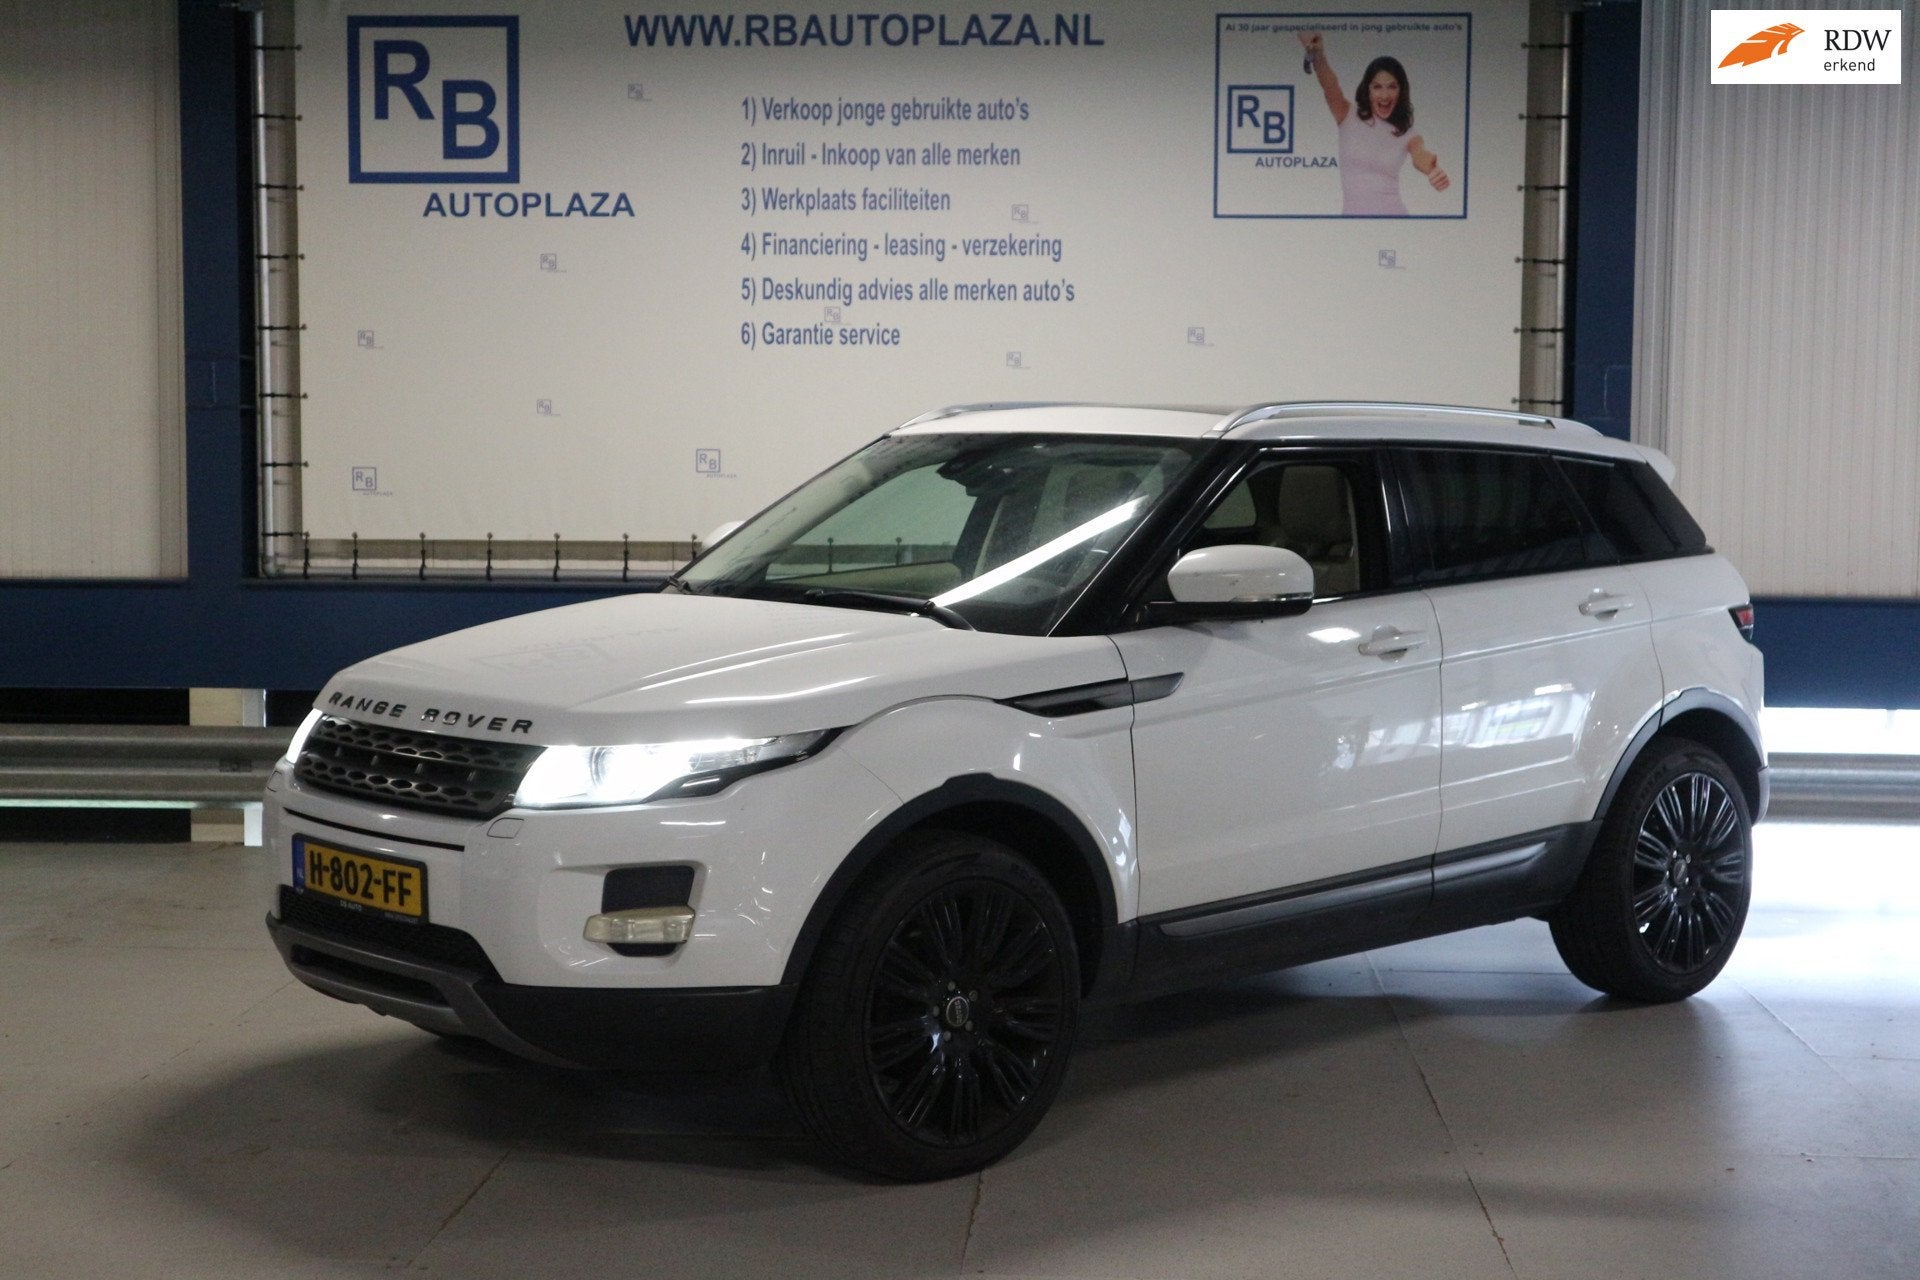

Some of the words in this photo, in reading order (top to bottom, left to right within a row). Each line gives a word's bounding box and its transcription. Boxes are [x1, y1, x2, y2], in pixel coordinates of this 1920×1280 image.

[623, 13, 1105, 47] WWW.RBAUTOPLAZA.NL
[374, 40, 500, 159] RB
[741, 96, 757, 126] 1)
[761, 96, 833, 126] Verkoop
[836, 96, 886, 127] jonge
[890, 96, 972, 127] gebruikte
[976, 96, 1030, 121] auto's
[1236, 94, 1287, 145] RB
[741, 141, 757, 172] 2)
[761, 141, 806, 166] Inruil
[821, 141, 881, 171] Inkoop
[885, 147, 917, 166] van
[921, 141, 952, 166] alle
[956, 142, 1021, 166] merken
[1255, 156, 1339, 169] AUTOPLAZA
[422, 191, 635, 218] AUTOPLAZA
[741, 186, 757, 216] 3)
[761, 186, 857, 216] Werkplaats
[861, 186, 951, 211] faciliteiten
[740, 232, 757, 261] 4)
[761, 231, 868, 262] Financiering
[884, 232, 946, 263] leasing
[961, 232, 1063, 263] verzekering
[741, 277, 757, 306] 5)
[762, 276, 853, 307] Deskundig
[857, 277, 914, 301] advies
[918, 277, 949, 302] alle
[953, 278, 1018, 302] merken
[1022, 278, 1075, 302] auto's
[740, 321, 757, 351] 6)
[761, 321, 834, 346] Garantie
[838, 323, 901, 346] service
[328, 691, 407, 718] RANGE
[420, 708, 534, 734] ROVER
[309, 850, 412, 907] H-802-FF
